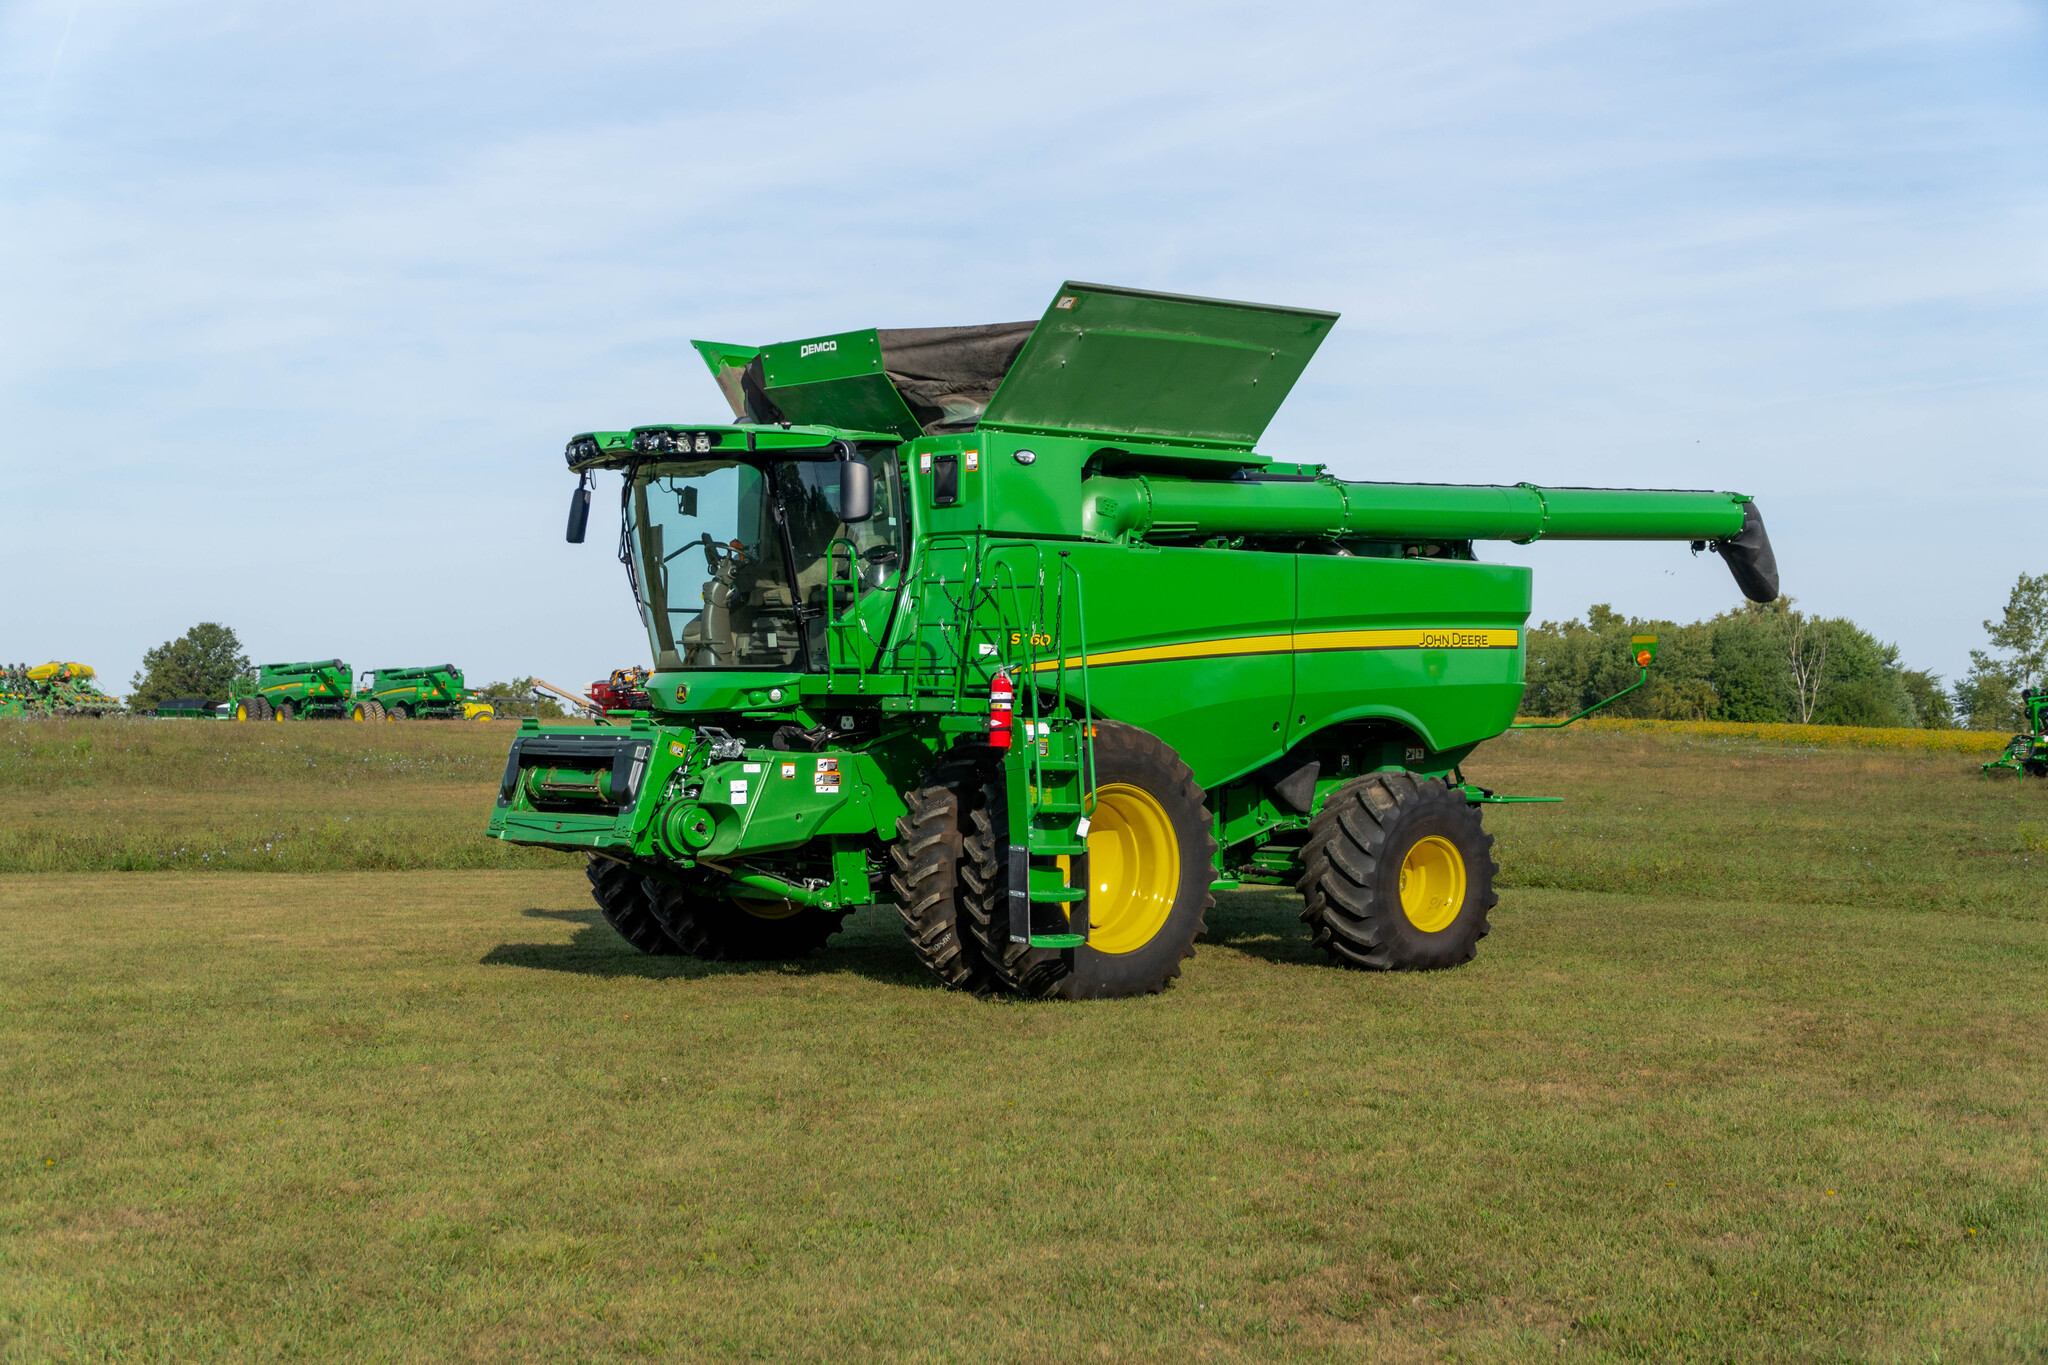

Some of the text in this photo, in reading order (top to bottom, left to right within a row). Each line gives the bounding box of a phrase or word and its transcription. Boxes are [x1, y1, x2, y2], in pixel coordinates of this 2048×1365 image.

[800, 340, 838, 358] DEMCO
[1010, 632, 1051, 647] S60
[1419, 632, 1488, 646] JOHN DEERE
